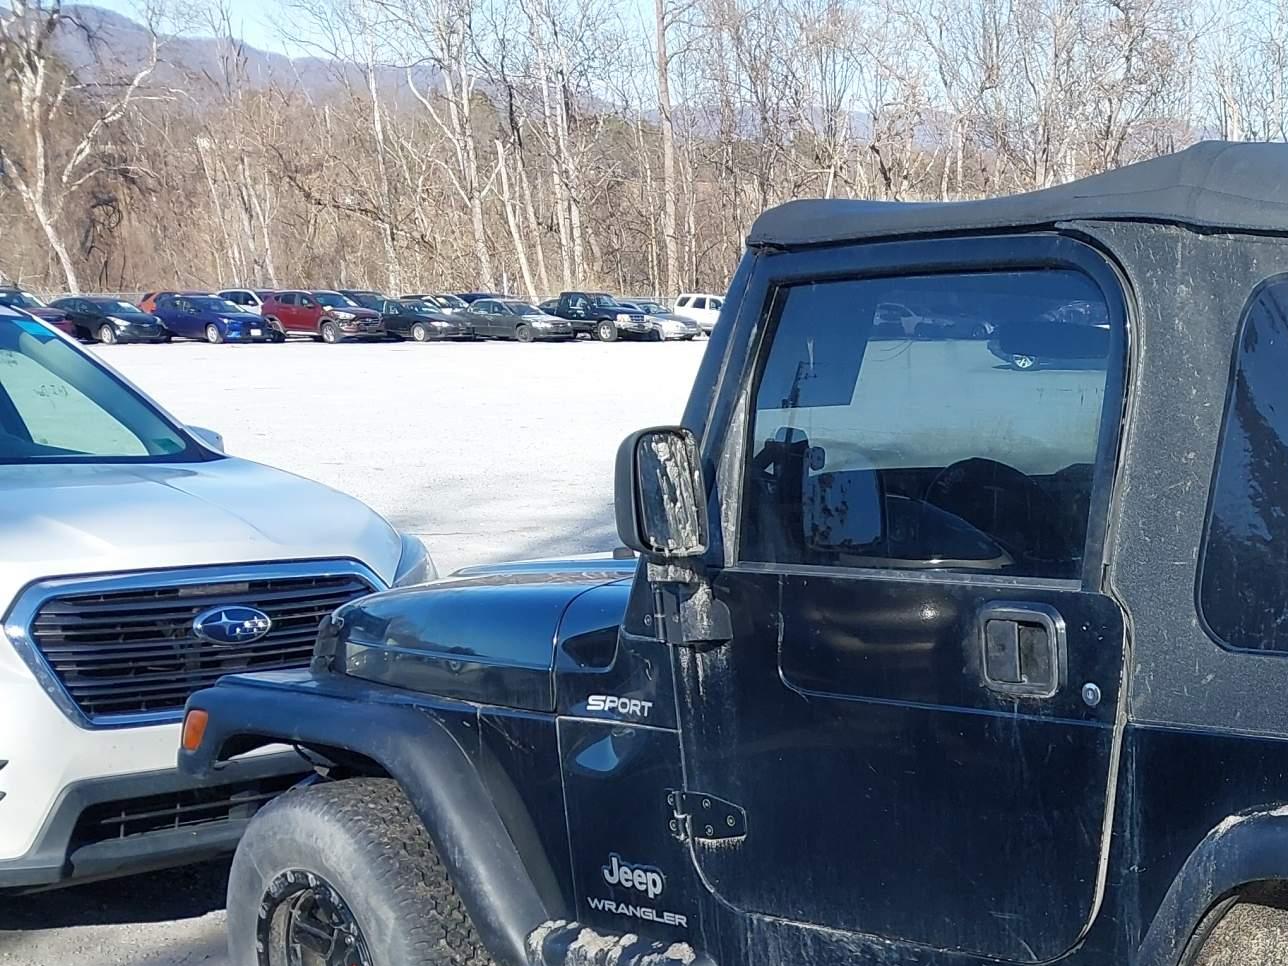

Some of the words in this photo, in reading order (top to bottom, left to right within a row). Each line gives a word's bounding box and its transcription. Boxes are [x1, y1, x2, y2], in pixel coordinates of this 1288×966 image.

[586, 694, 653, 718] SPORT
[603, 856, 664, 899] Jeep
[586, 896, 688, 928] WRANGLER
